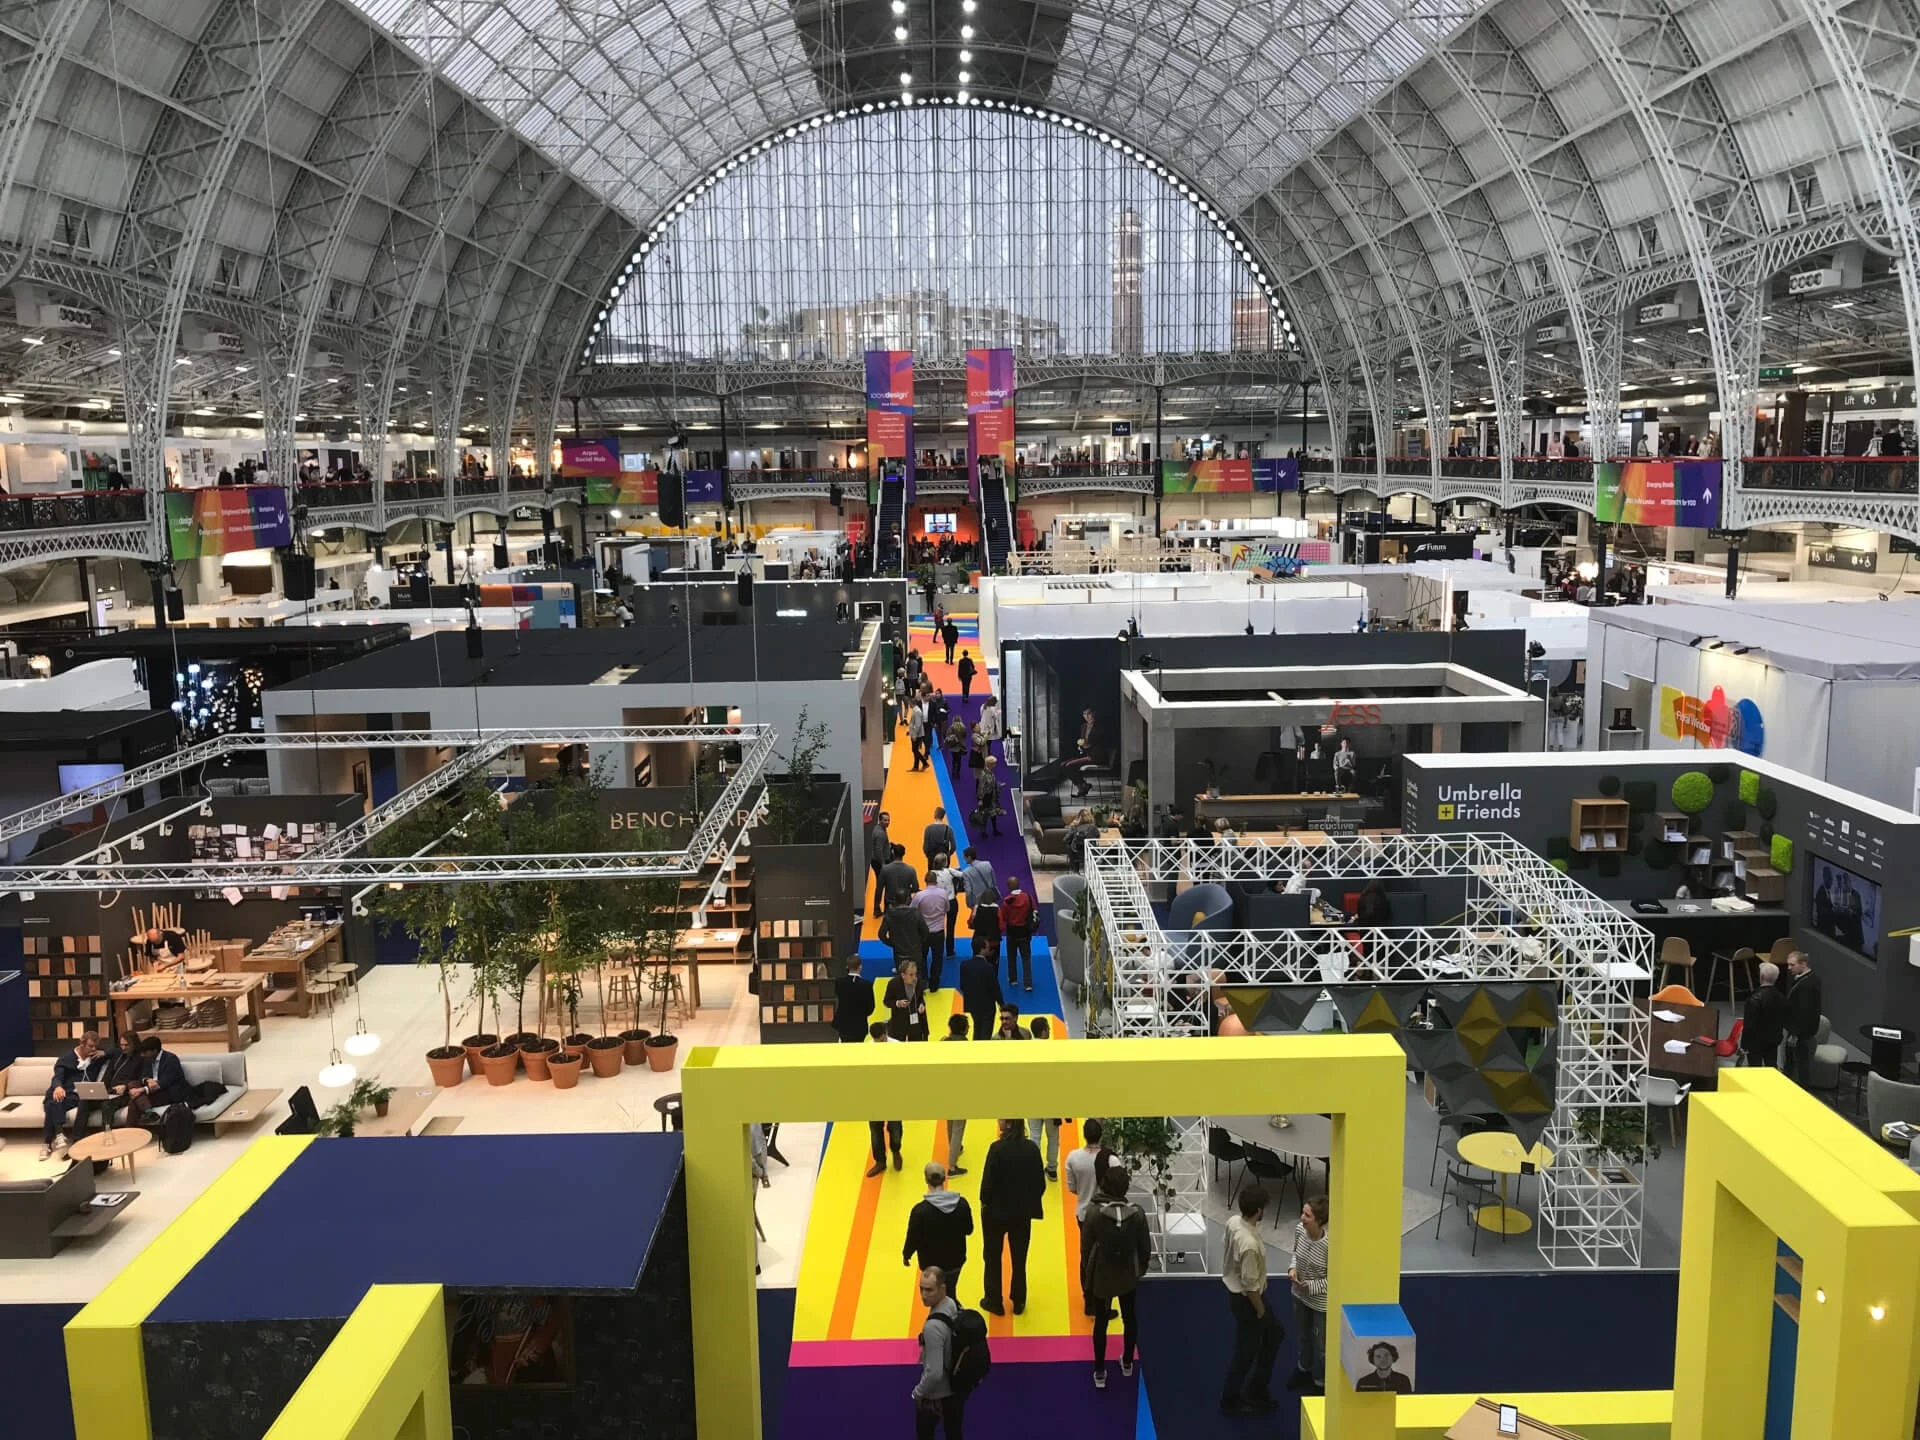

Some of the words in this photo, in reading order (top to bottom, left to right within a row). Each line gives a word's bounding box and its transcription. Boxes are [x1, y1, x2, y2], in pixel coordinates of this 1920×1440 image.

[1844, 395, 1855, 405] Lift
[1825, 552, 1835, 563] Lift
[1438, 782, 1522, 801] Umbrella
[1456, 801, 1521, 820] Friends
